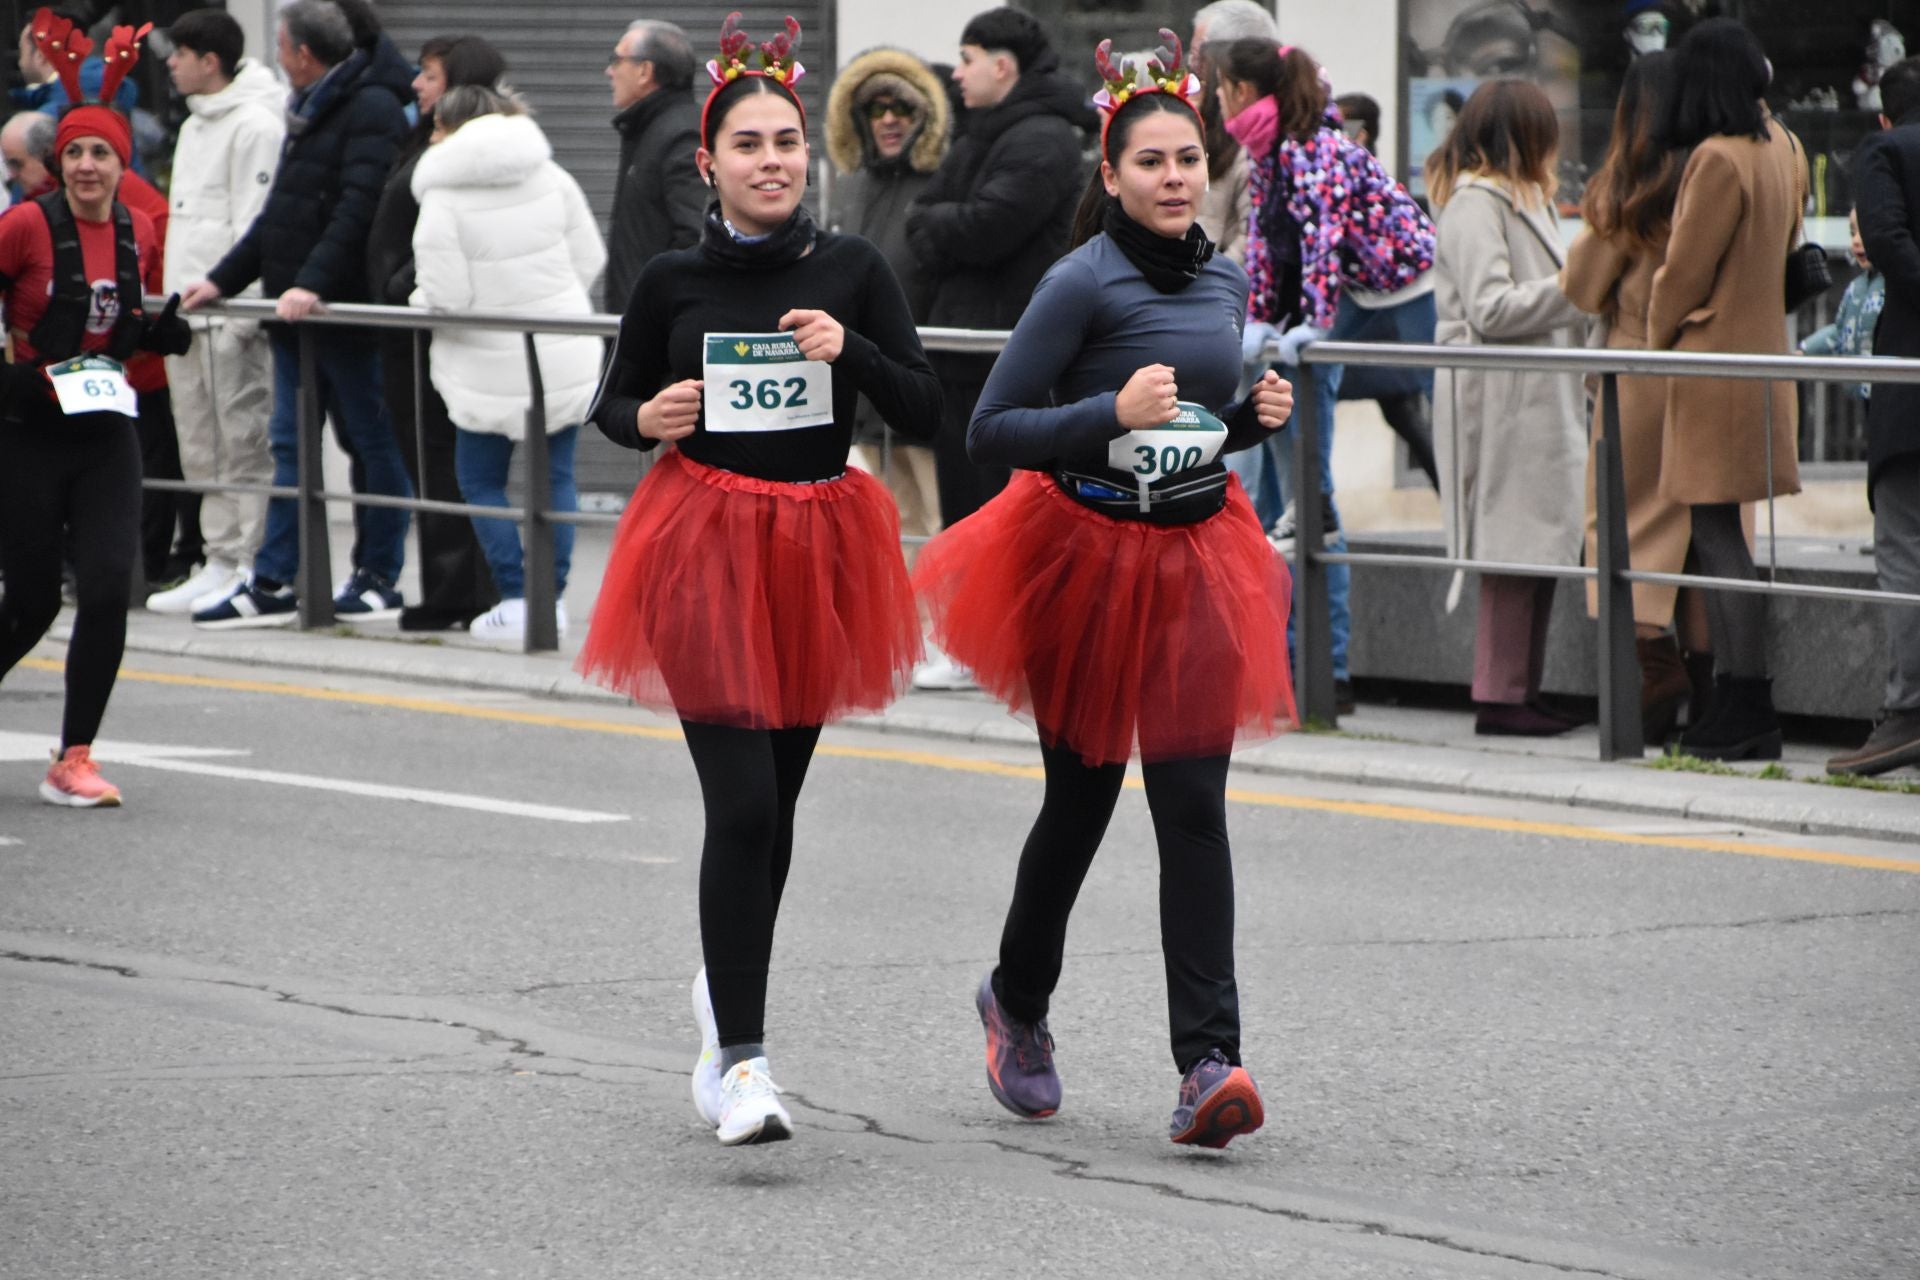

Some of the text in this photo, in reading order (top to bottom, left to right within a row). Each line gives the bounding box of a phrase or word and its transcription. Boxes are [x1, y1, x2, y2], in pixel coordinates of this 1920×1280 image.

[752, 341, 796, 351] CAJA RURAL
[765, 348, 800, 356] NAVARRA
[83, 379, 117, 397] 63
[729, 376, 808, 410] 362
[1132, 445, 1203, 476] 300
